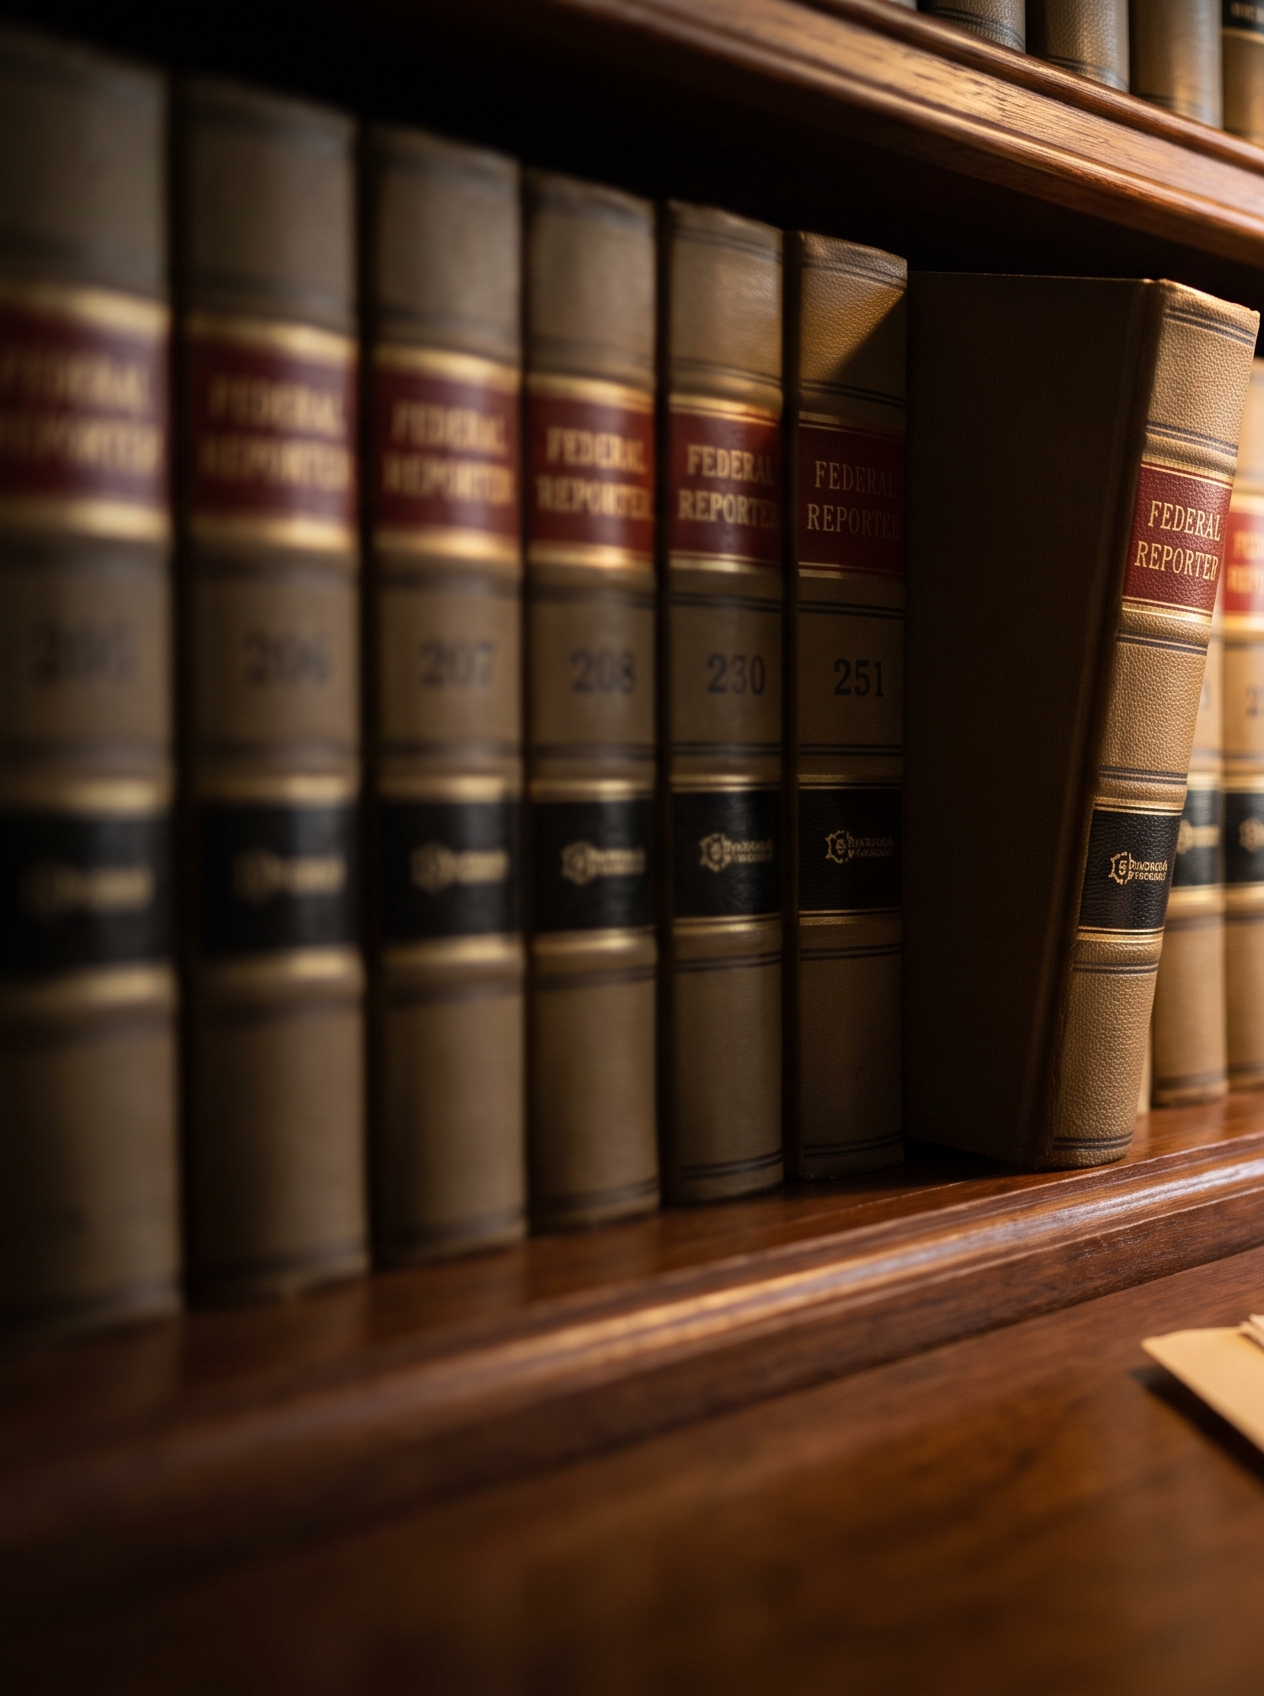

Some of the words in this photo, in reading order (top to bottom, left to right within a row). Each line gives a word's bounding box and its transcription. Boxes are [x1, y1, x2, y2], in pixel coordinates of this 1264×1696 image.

[546, 426, 647, 474] FEDERAL
[687, 443, 775, 486] FEDERAL
[814, 460, 897, 499] FEDERAL
[677, 488, 779, 529] REPORTER
[806, 503, 902, 541] REPORTER
[1147, 500, 1221, 542] FEDERAL
[1134, 540, 1219, 581] REPORTER
[569, 648, 639, 696] 208
[706, 652, 766, 697] 230
[833, 658, 885, 698] 251
